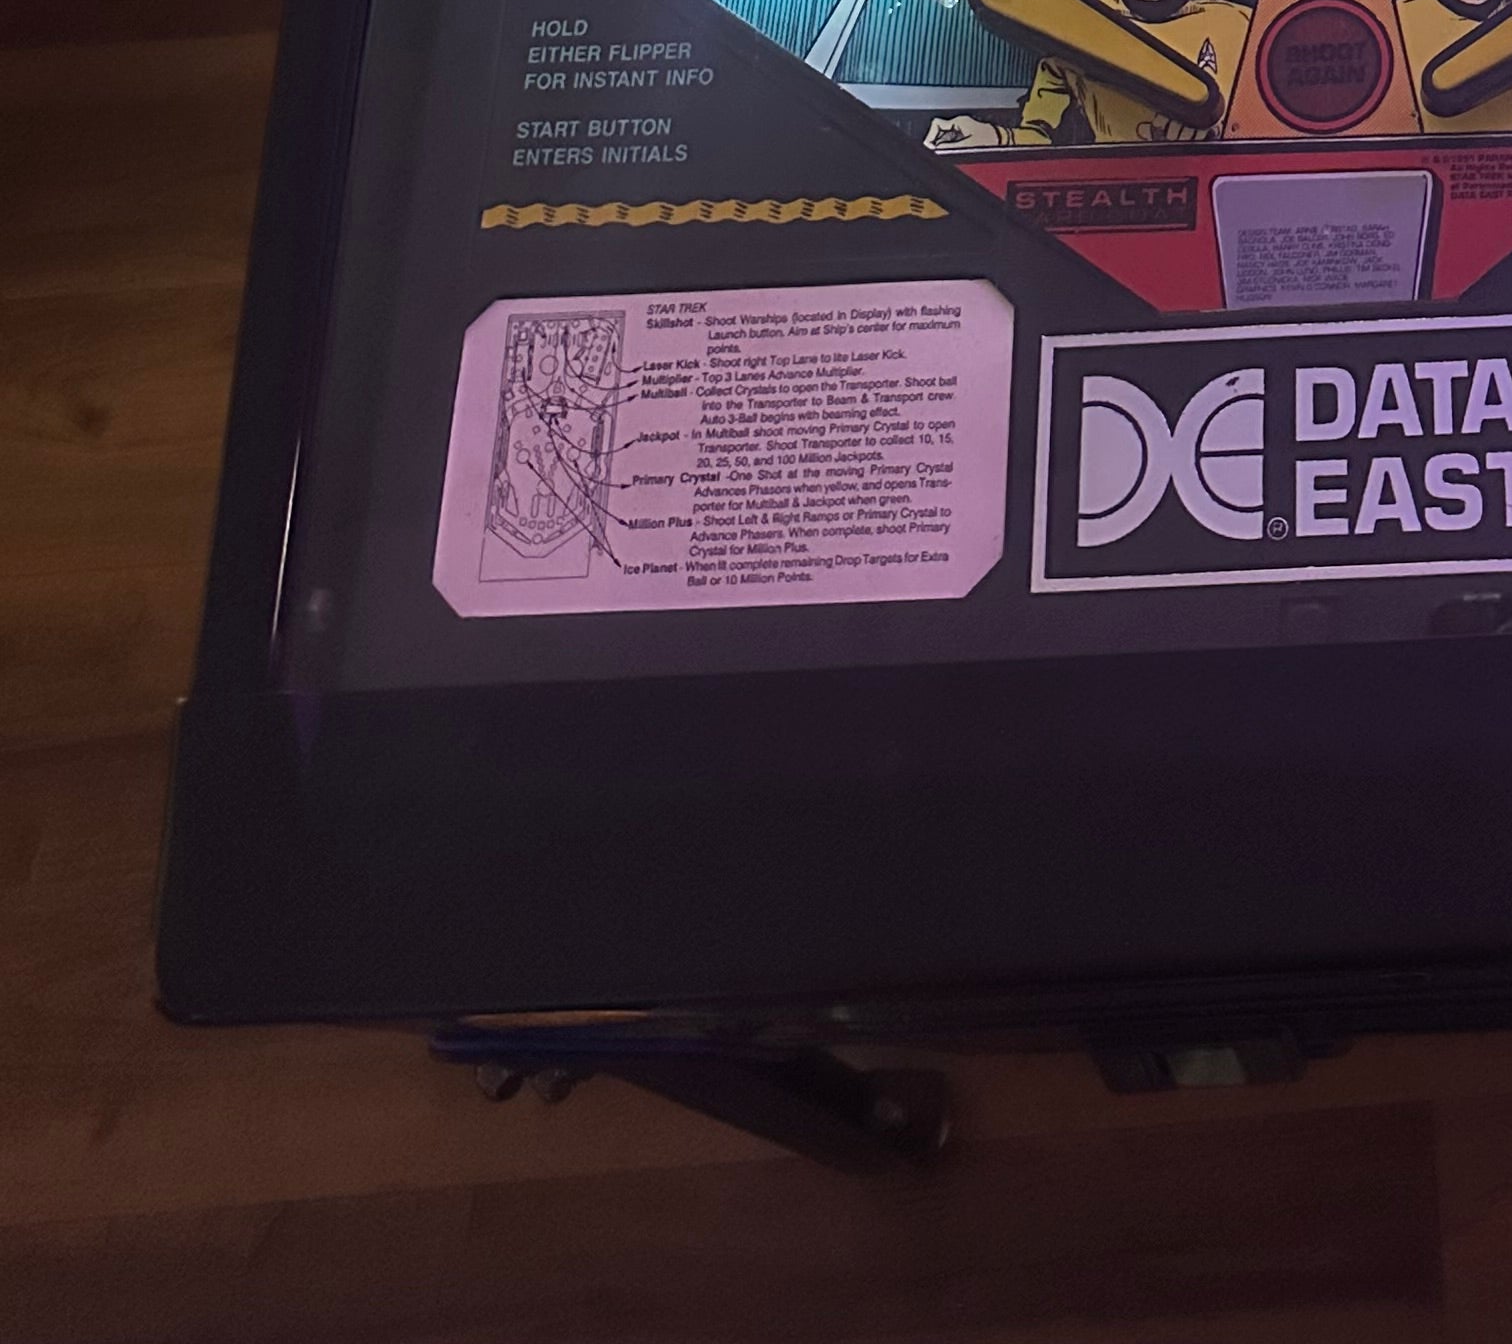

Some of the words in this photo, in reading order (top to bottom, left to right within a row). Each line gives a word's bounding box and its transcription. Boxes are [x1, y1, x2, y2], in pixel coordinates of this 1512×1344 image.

[531, 19, 589, 38] HOLD
[528, 44, 602, 65] EITHER
[608, 42, 692, 62] FLIPPER
[523, 72, 568, 91] FOR
[573, 69, 660, 89] INSTANT
[666, 68, 714, 87] INFO
[516, 118, 581, 139] START
[587, 117, 672, 138] BUTTON
[512, 146, 594, 167] ENTERS
[601, 143, 688, 164] INITIALS
[1015, 187, 1189, 210] STEALTH
[647, 304, 676, 315] STAR
[679, 302, 708, 313] TREK
[646, 318, 693, 329] Skillshot
[704, 315, 736, 326] Shoot
[739, 313, 788, 325] Warships
[643, 361, 674, 371] Laser
[676, 359, 700, 370] Kick
[709, 357, 741, 368] Shoot
[770, 354, 790, 367] Top
[851, 350, 880, 361] Laser
